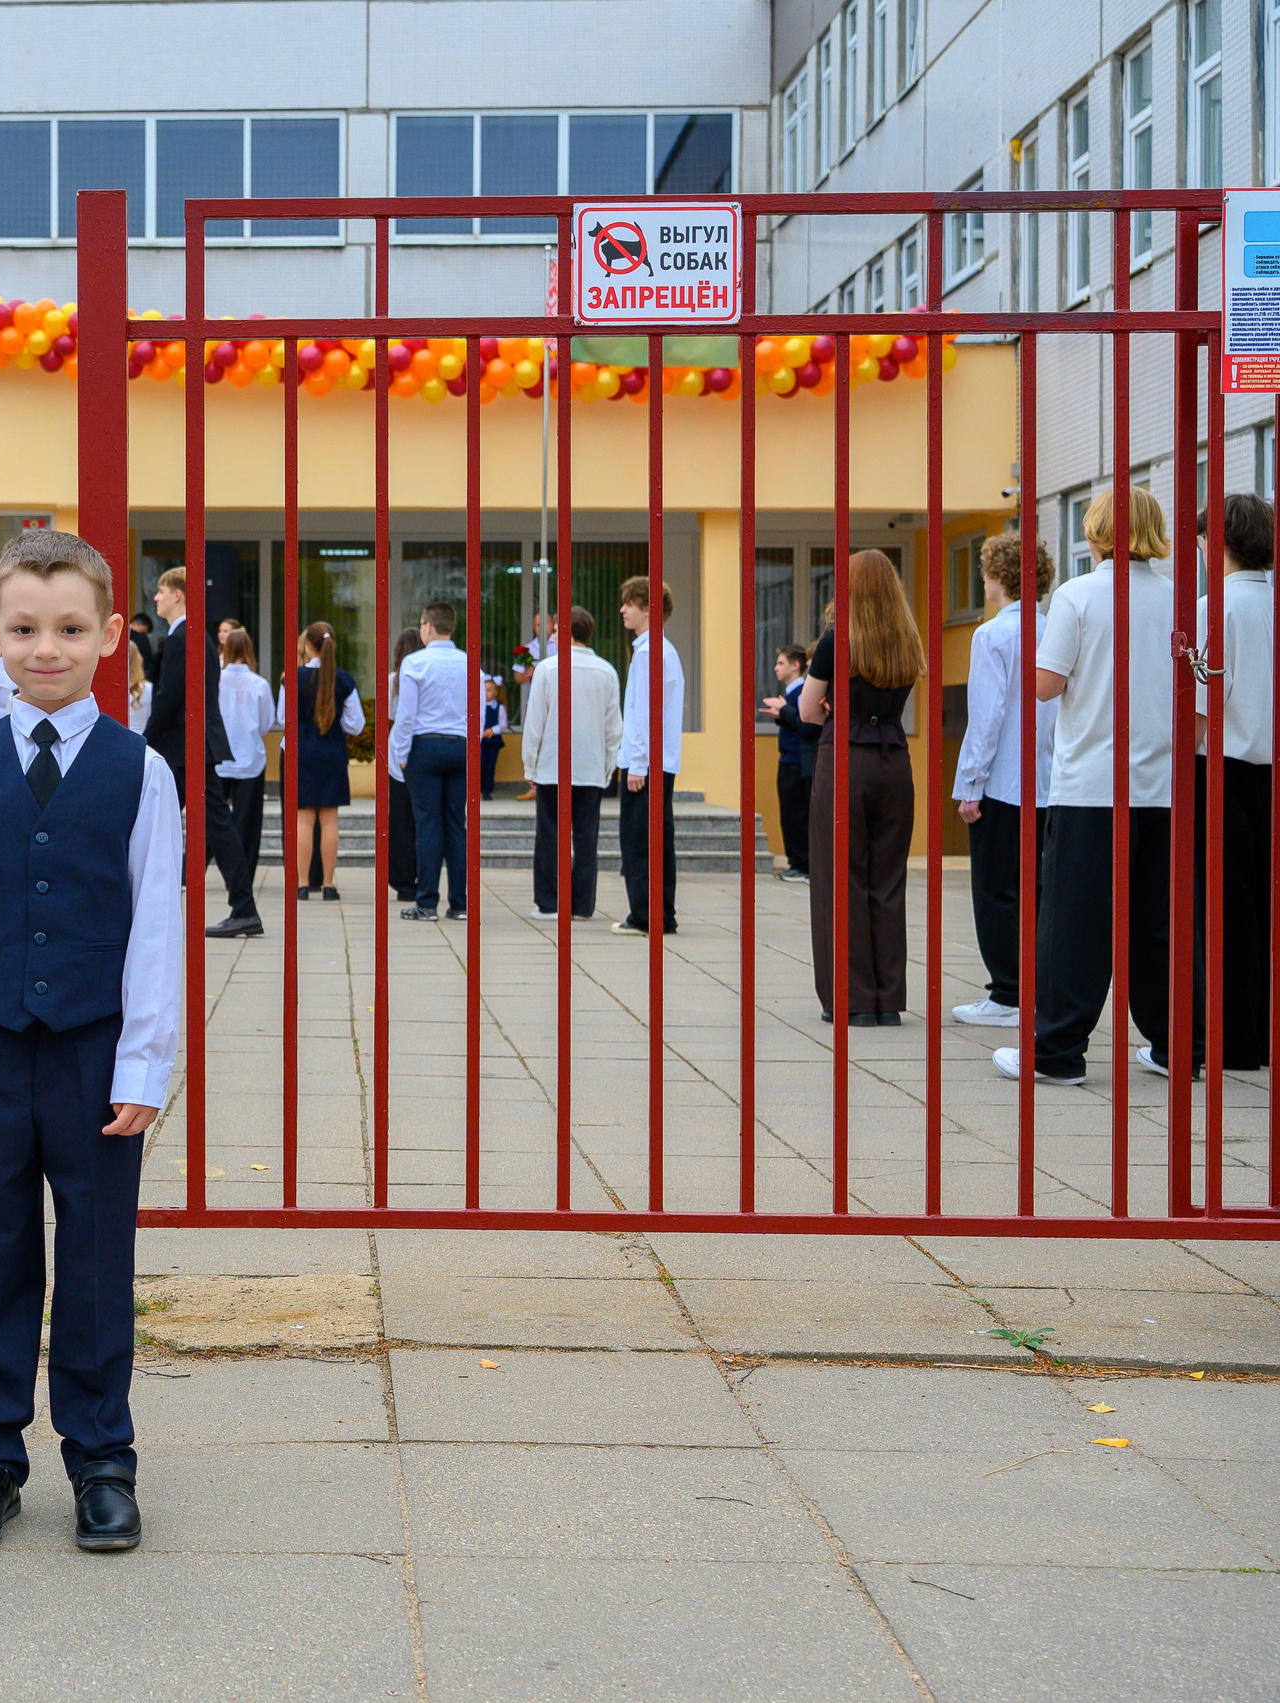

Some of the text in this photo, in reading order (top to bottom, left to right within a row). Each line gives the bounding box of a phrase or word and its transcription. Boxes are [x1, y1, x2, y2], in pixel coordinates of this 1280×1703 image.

[660, 226, 728, 244] ВЫГУЛ
[660, 252, 728, 270] СОБАК
[587, 280, 728, 313] ЗАПРЕЩЁН
